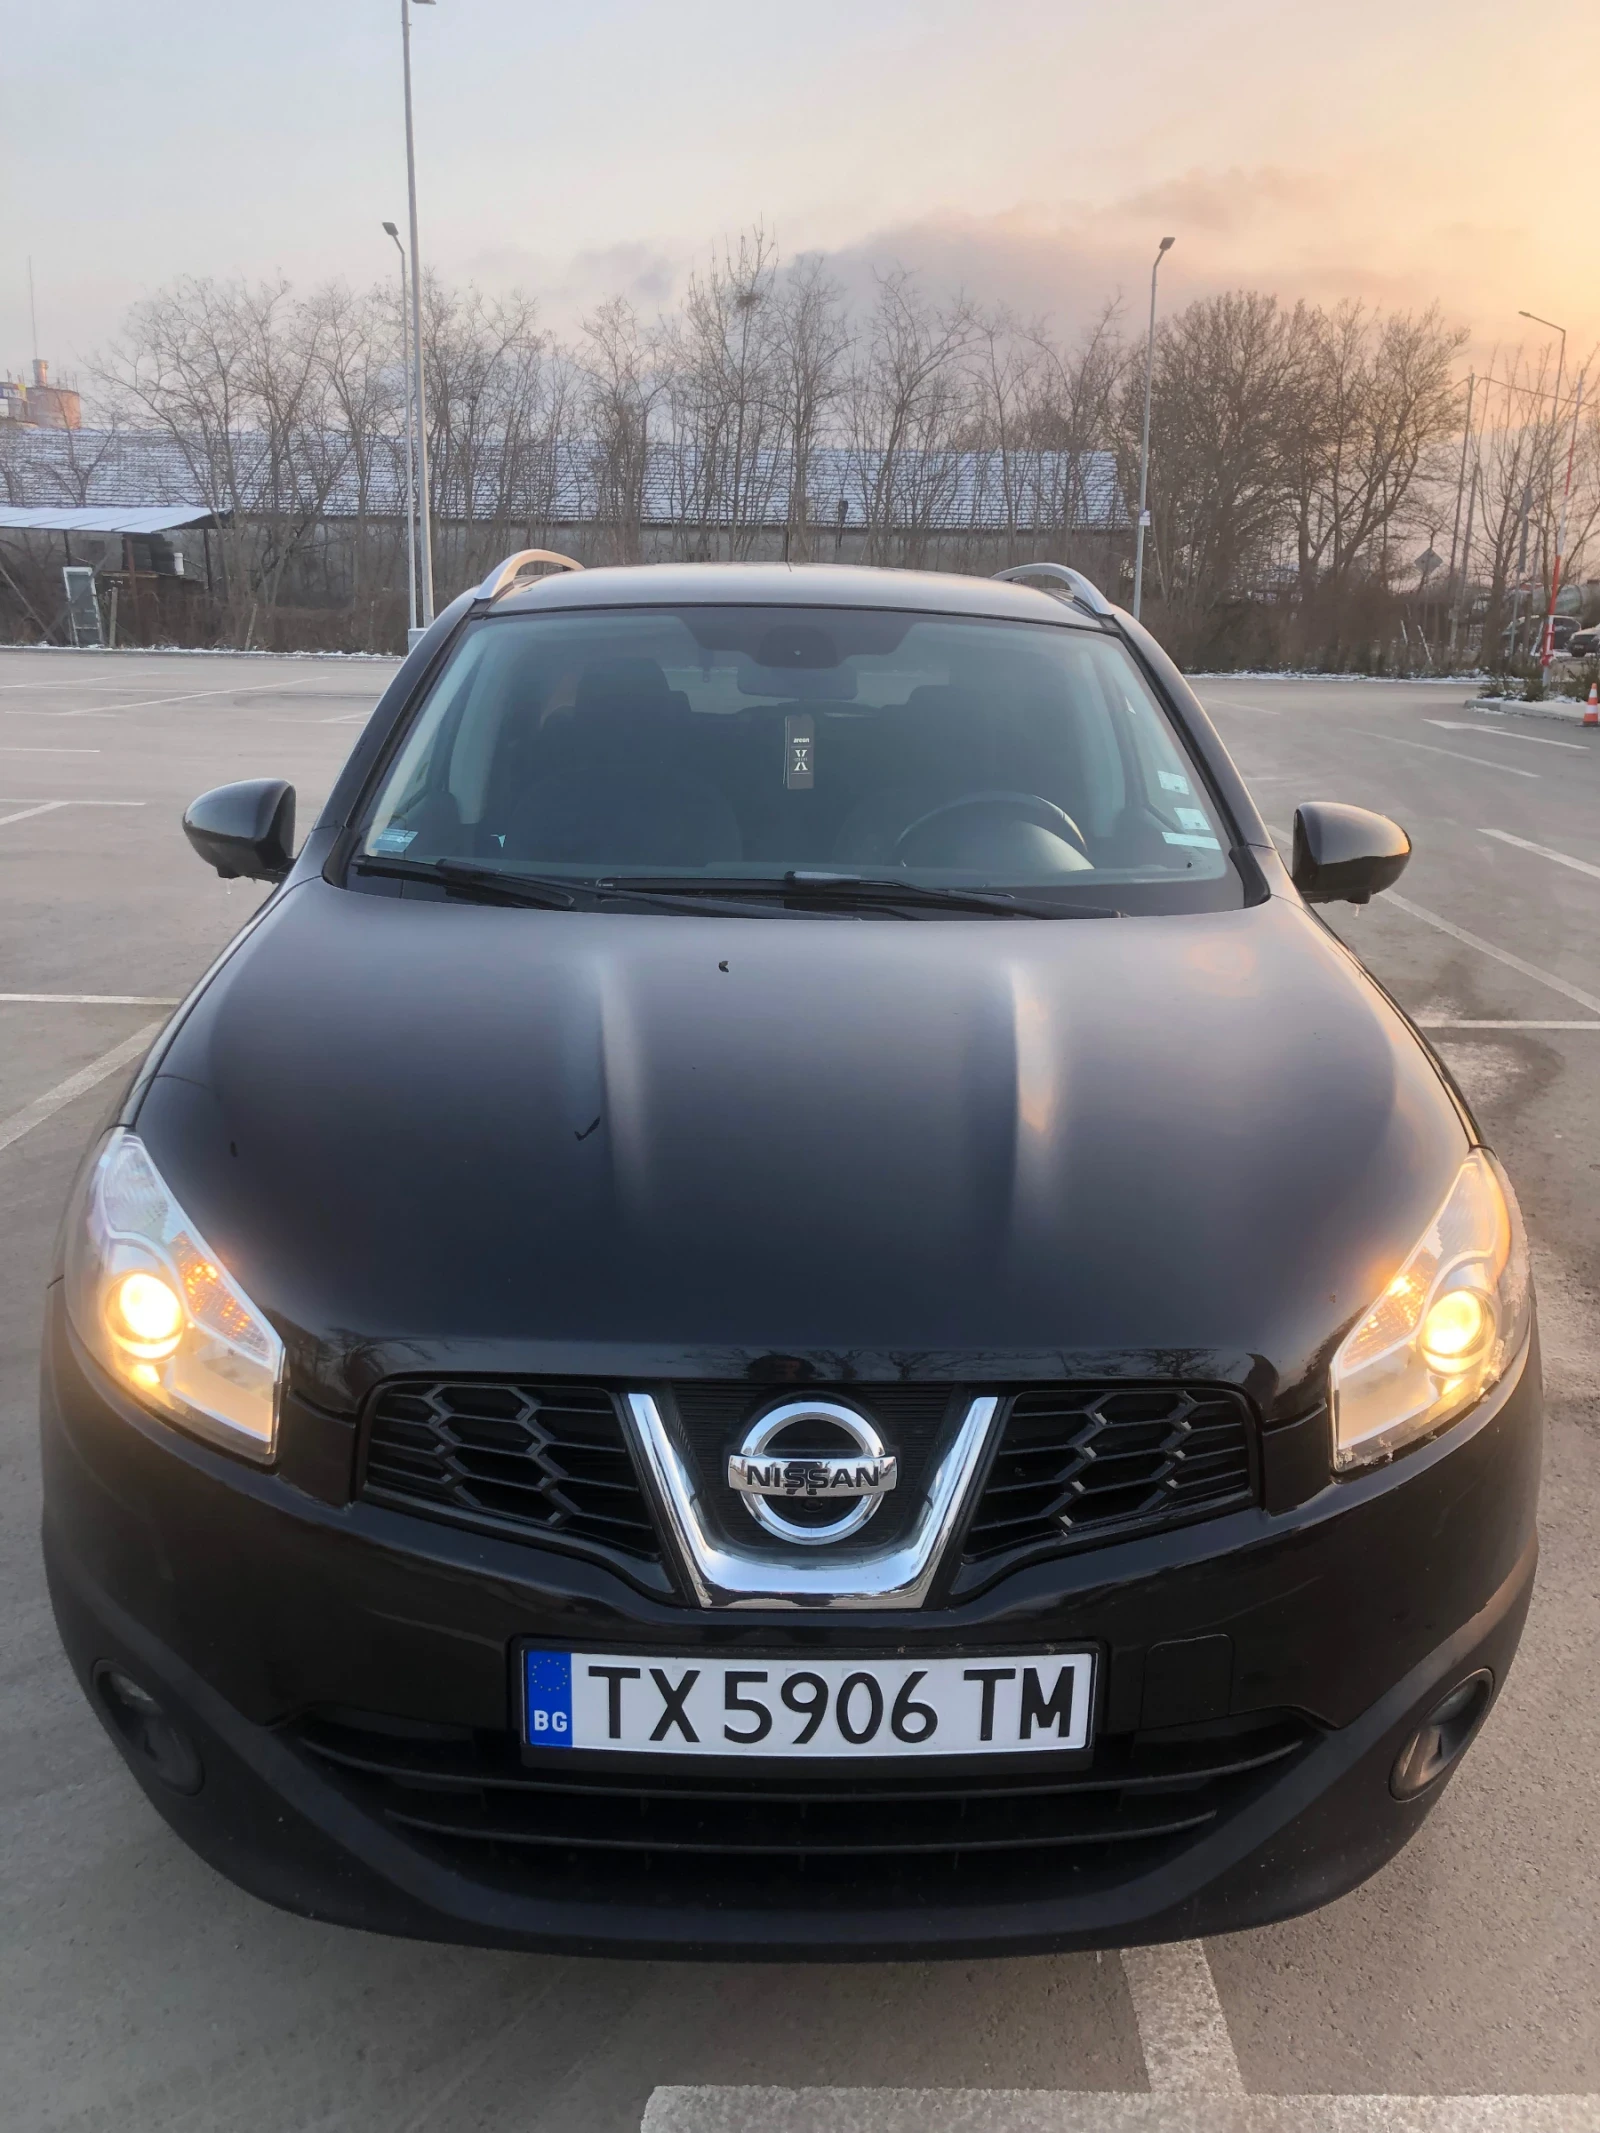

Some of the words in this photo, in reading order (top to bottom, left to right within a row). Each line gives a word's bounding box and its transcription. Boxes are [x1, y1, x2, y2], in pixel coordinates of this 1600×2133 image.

[746, 1465, 880, 1489] NISSAN
[588, 1665, 701, 1743] TX
[724, 1670, 939, 1744] 5906
[963, 1665, 1075, 1742] TM
[533, 1709, 568, 1732] BG
